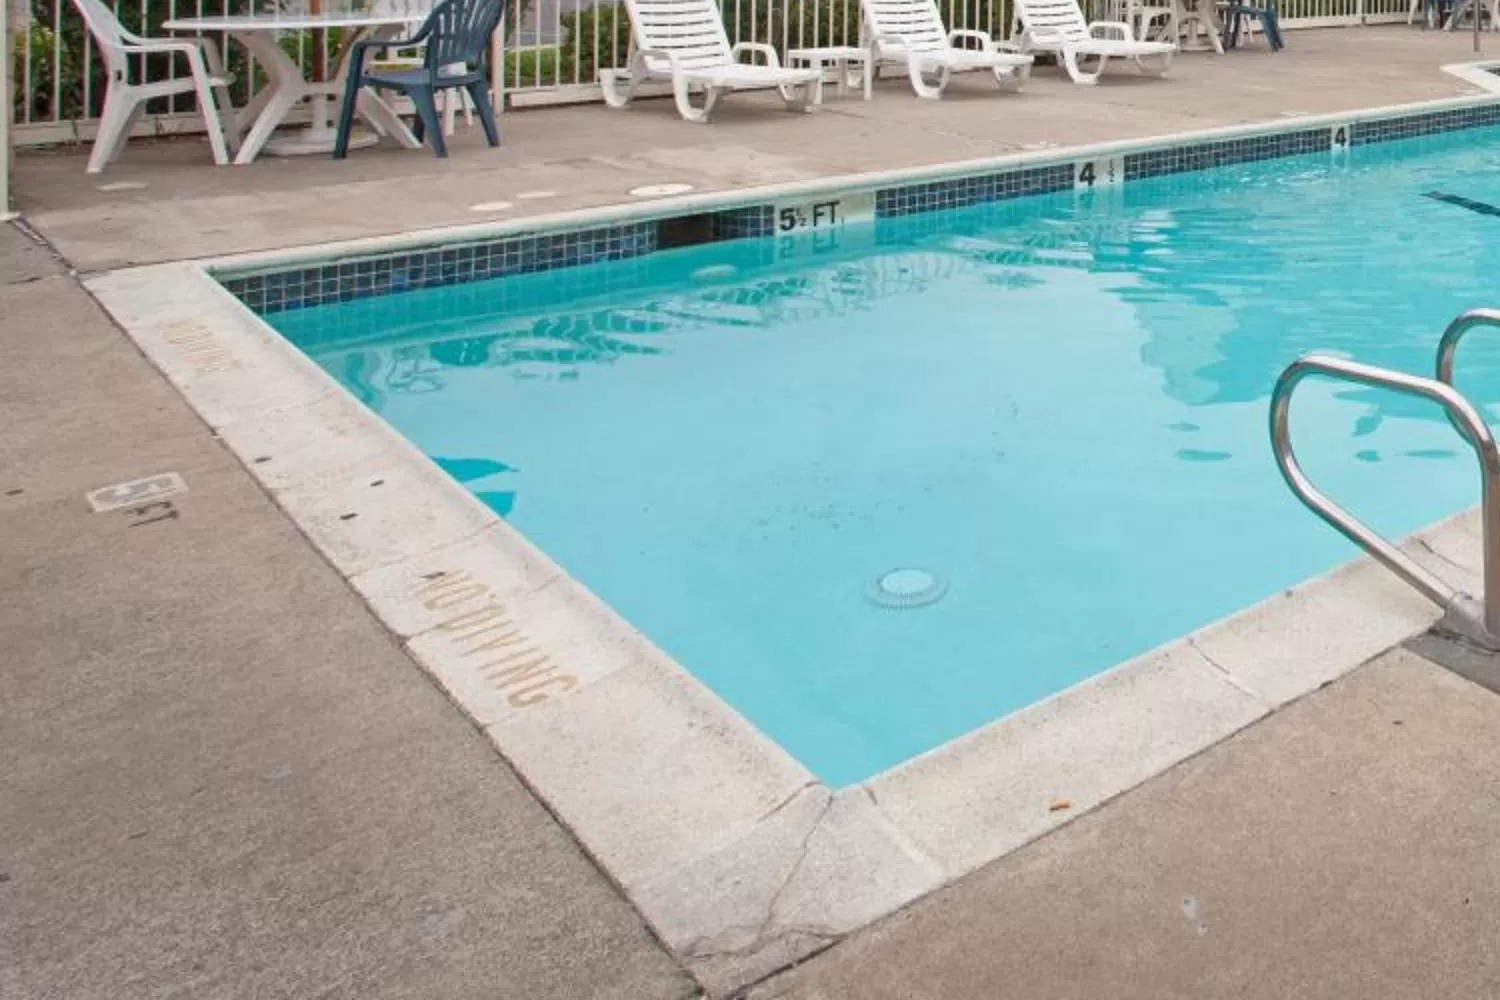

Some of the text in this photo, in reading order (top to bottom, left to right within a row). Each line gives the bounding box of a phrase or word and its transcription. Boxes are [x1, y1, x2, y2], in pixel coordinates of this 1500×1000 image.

[1333, 127, 1347, 147] 4
[1079, 162, 1096, 186] 4
[813, 200, 840, 227] FT
[124, 500, 179, 529] FT
[407, 570, 577, 708] NO DIVING
